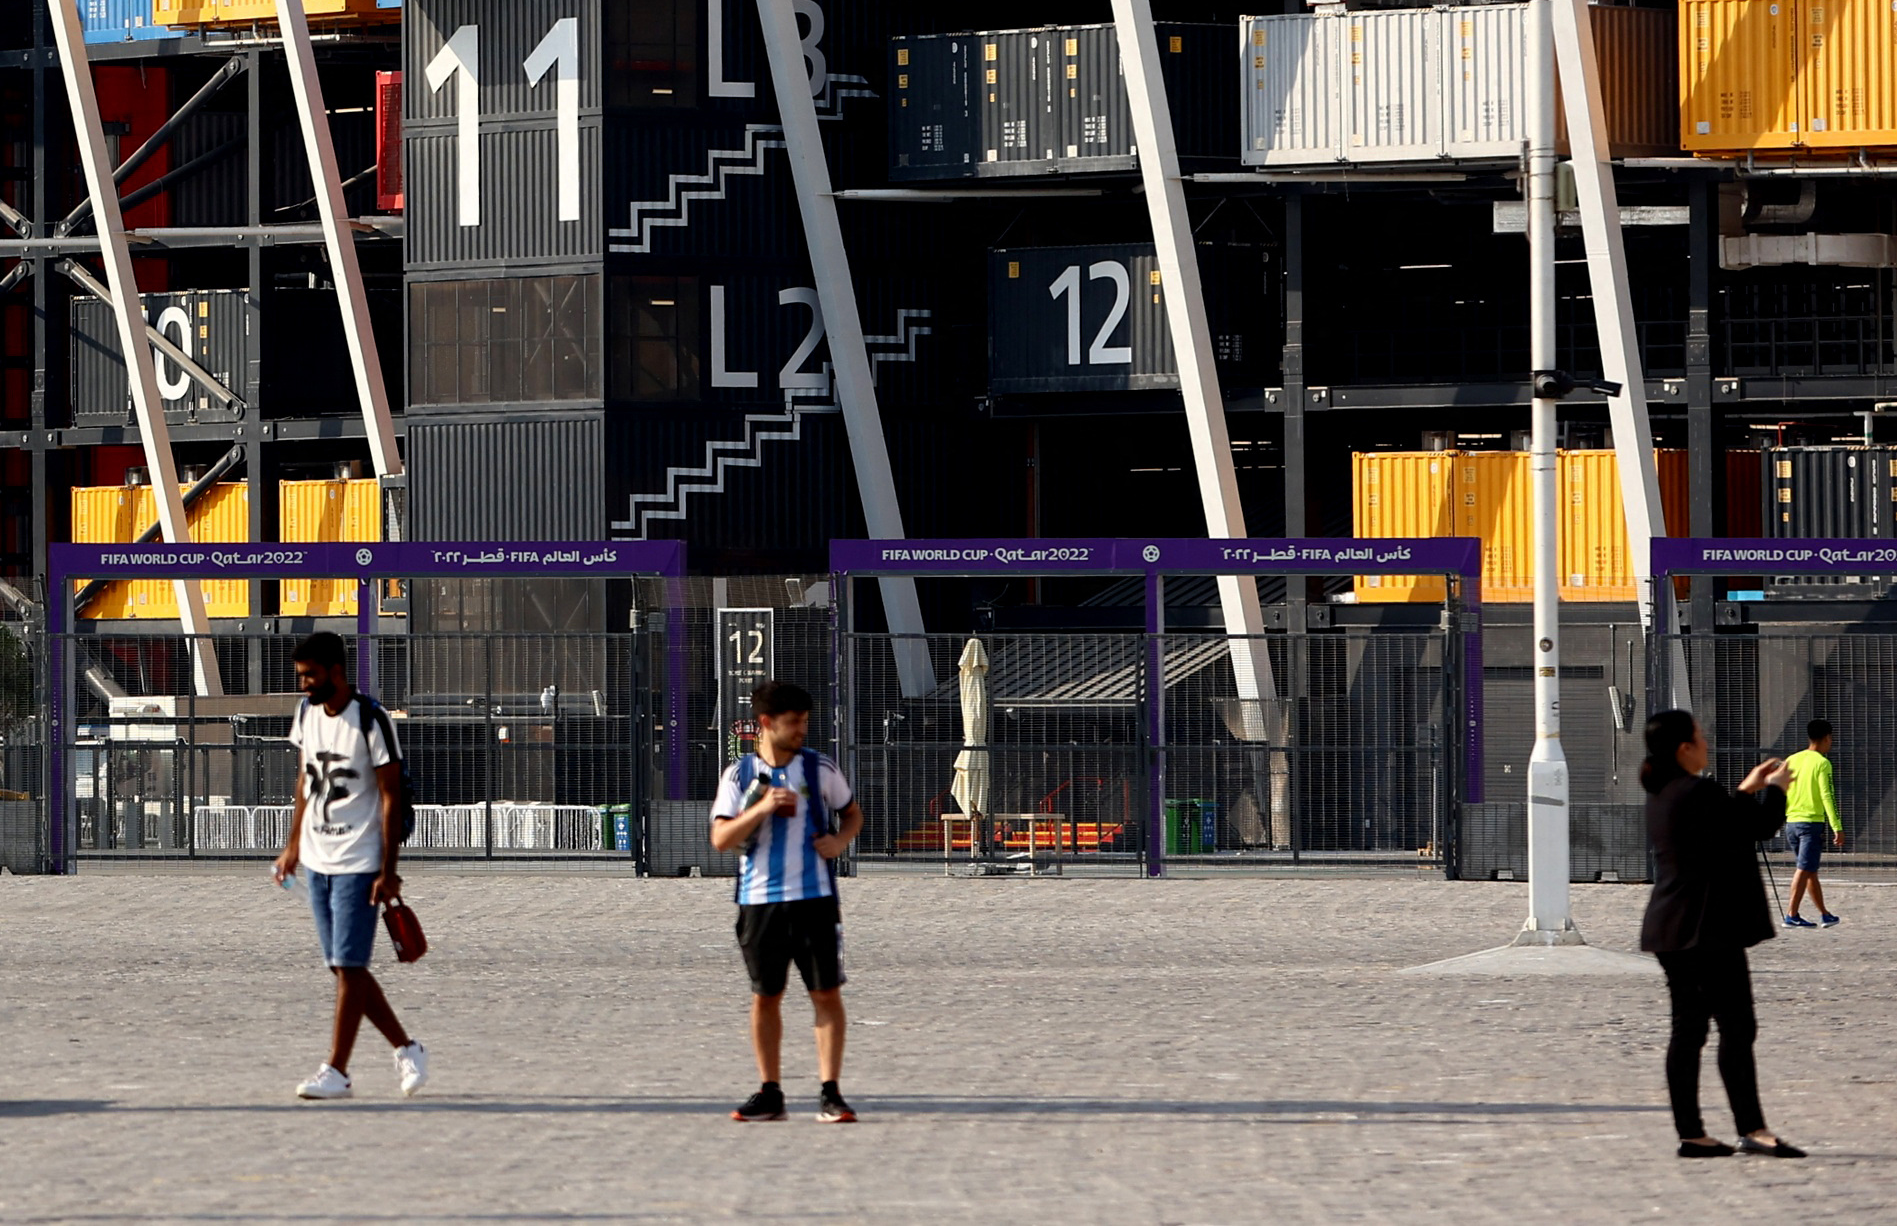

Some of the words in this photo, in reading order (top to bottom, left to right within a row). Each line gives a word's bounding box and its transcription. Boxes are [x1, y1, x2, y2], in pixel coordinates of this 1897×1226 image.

[424, 17, 580, 227] 11
[1048, 259, 1132, 366] 12
[709, 284, 830, 389] L2
[101, 554, 129, 565] FIFA
[130, 554, 178, 565] WORLD
[179, 554, 205, 565] CUP
[510, 551, 540, 562] FIFA
[542, 551, 580, 565] العالم
[583, 548, 617, 565] كأس
[882, 550, 911, 561] FIFA
[912, 550, 961, 561] WORLD
[962, 550, 989, 561] CUP
[1302, 549, 1332, 560] FIFA
[1334, 549, 1373, 562] العالم
[1376, 546, 1411, 562] كأس
[1703, 550, 1733, 561] FIFA
[1734, 550, 1784, 561] WORLD
[1786, 550, 1813, 561] CUP
[728, 629, 764, 664] 12
